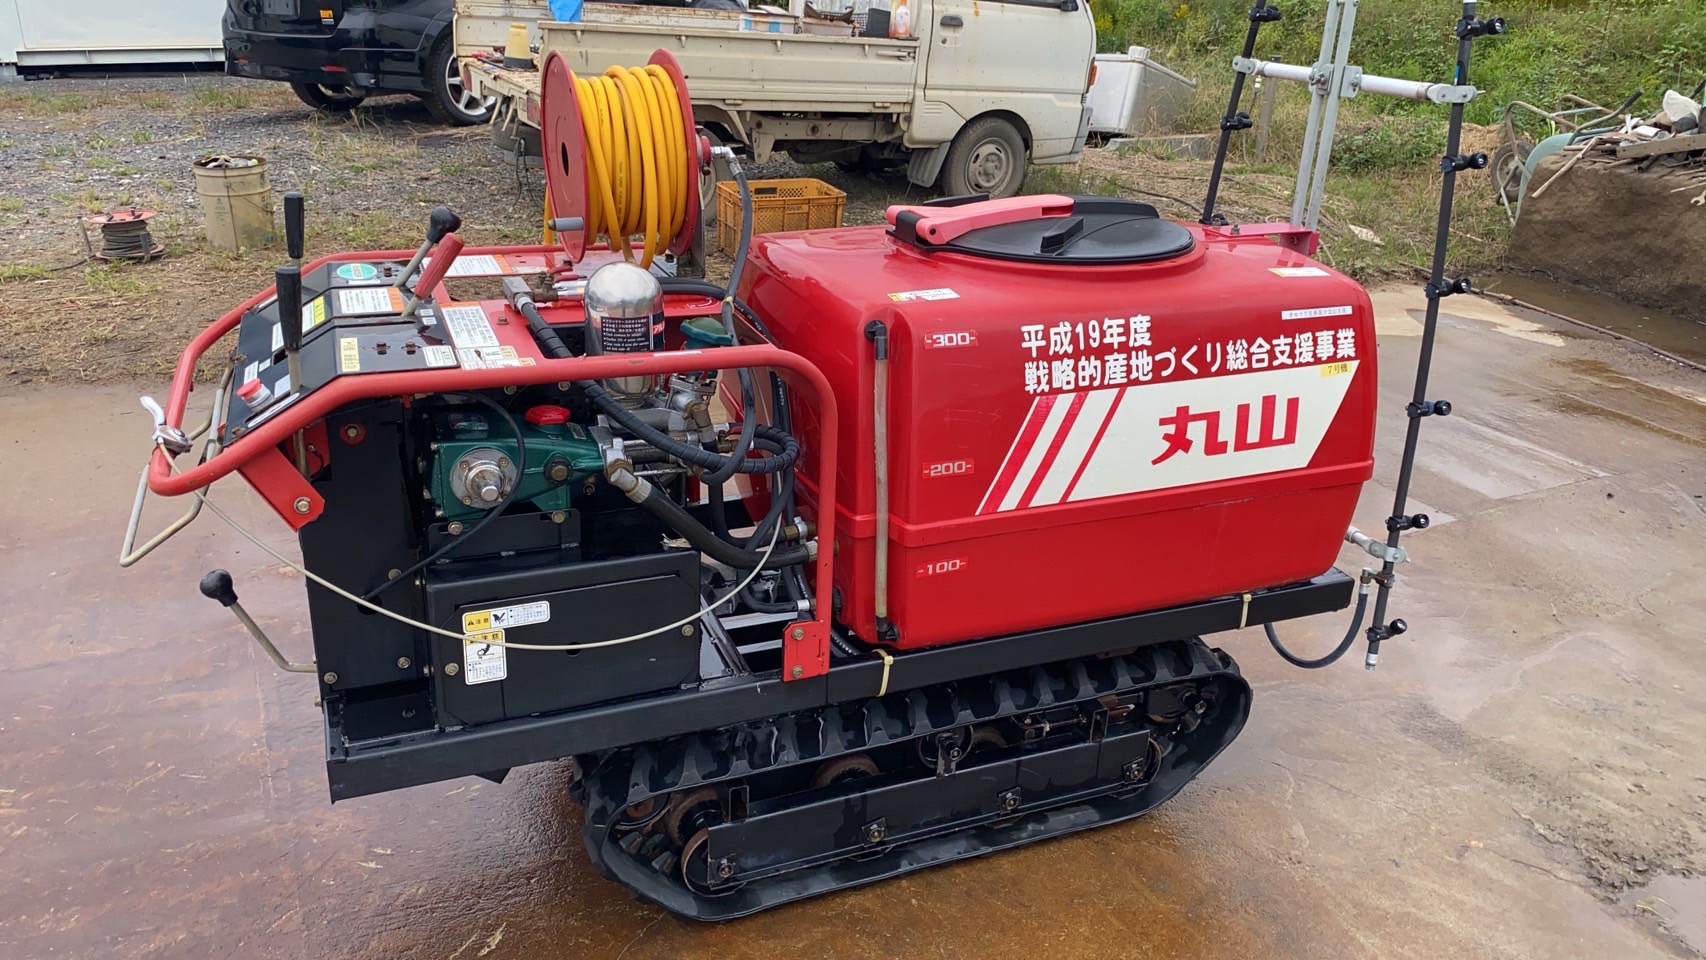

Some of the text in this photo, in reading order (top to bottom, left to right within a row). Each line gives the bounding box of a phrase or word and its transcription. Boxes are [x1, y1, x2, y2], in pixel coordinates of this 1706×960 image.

[1021, 314, 1152, 358] 平成19年度
[1024, 328, 1357, 394] 戦略的産地づくり総合支援事業
[1151, 394, 1300, 466] 丸山
